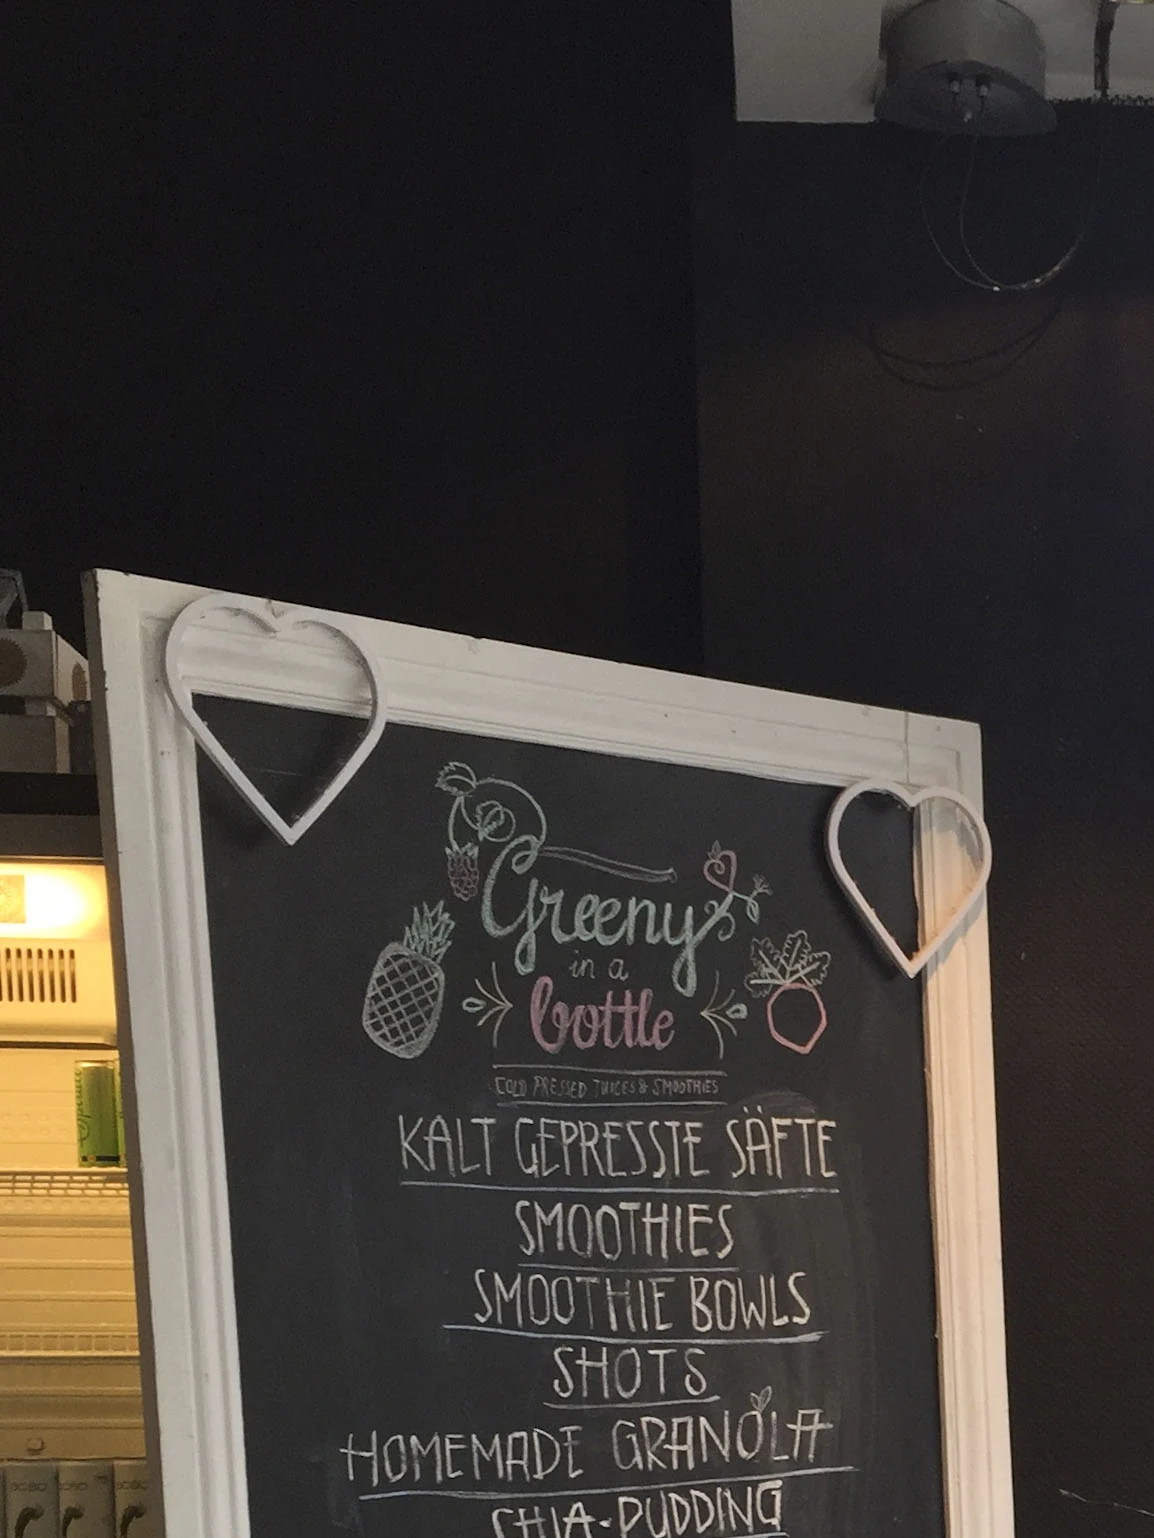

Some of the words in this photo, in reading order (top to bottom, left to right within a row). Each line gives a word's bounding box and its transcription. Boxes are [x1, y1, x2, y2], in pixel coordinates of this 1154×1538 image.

[481, 836, 725, 996] Greeny
[569, 951, 596, 980] in
[609, 957, 631, 981] a
[530, 975, 676, 1053] bottle
[398, 1113, 498, 1175] KALT
[514, 1115, 709, 1178] GEPRESSTE
[726, 1105, 839, 1178] SÄFTE
[515, 1200, 735, 1261] SMOOTHIES
[474, 1268, 674, 1332] SMOOTHIE
[690, 1271, 811, 1332] BOWLS
[553, 1345, 709, 1398] SHOTS
[341, 1423, 584, 1486] HOMEMADE
[612, 1407, 833, 1471] GRANOLA
